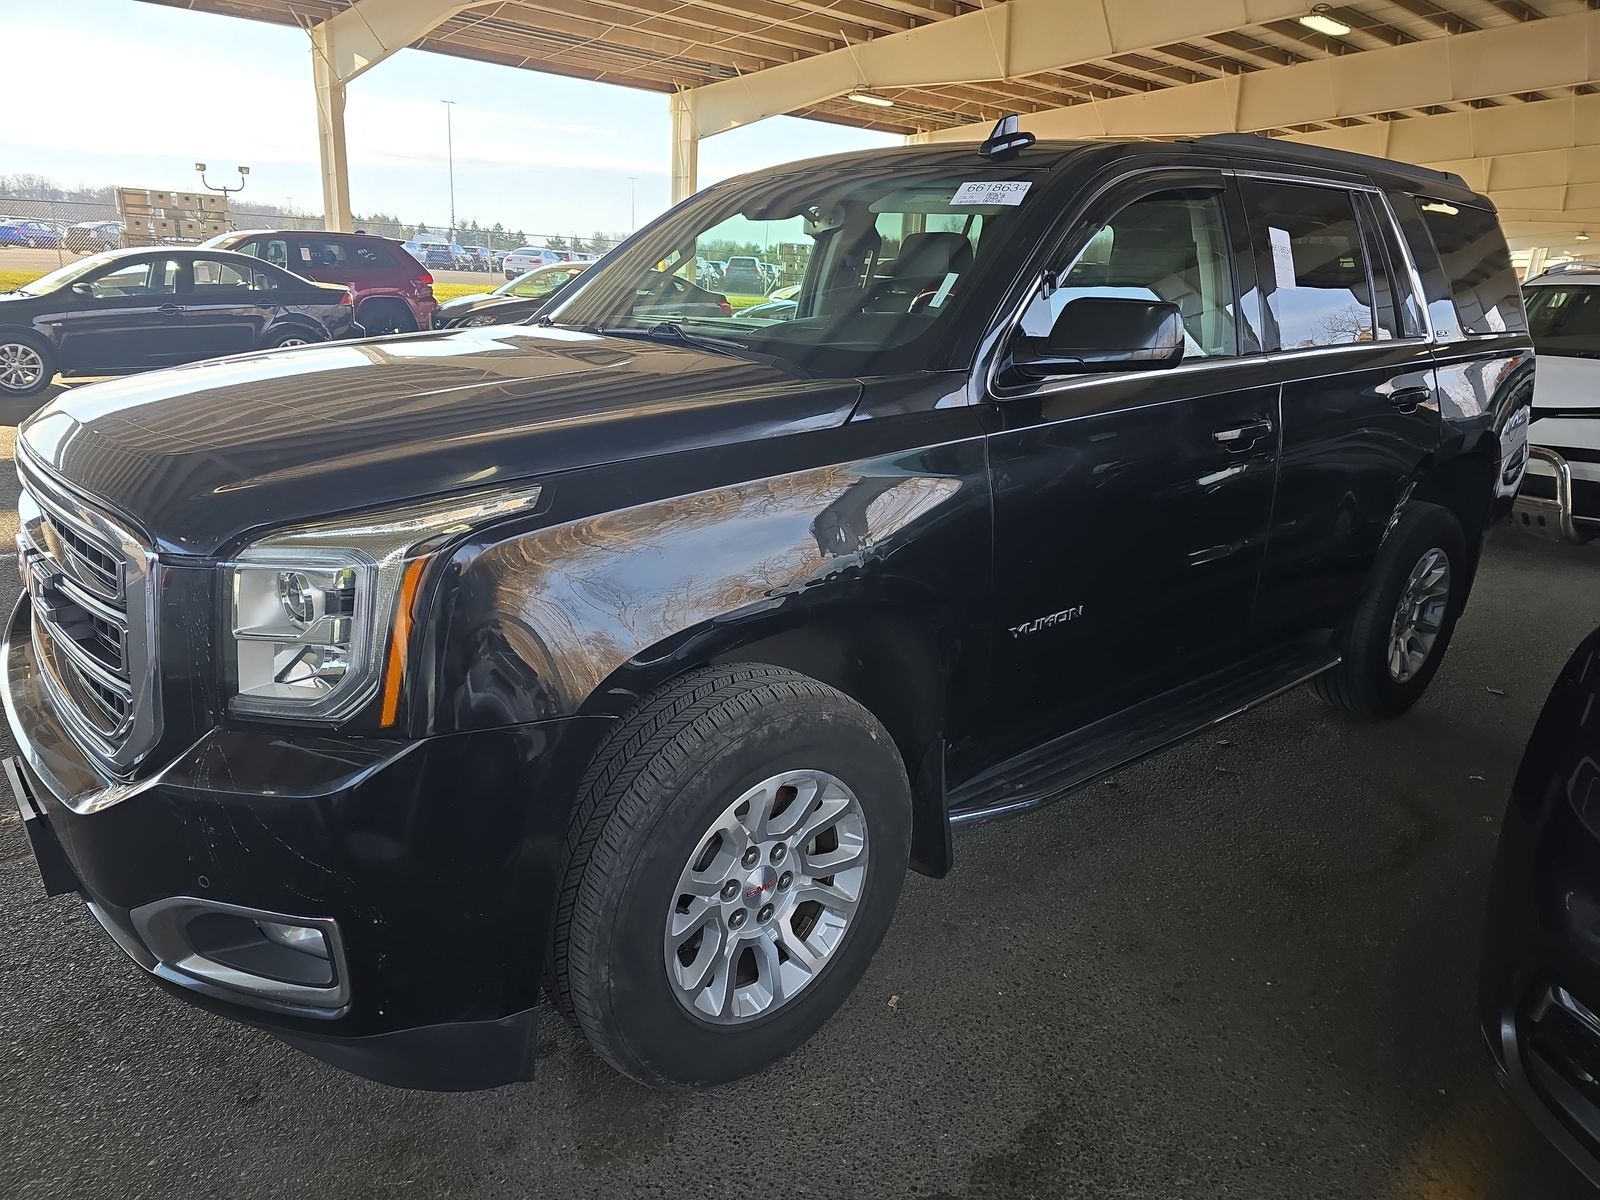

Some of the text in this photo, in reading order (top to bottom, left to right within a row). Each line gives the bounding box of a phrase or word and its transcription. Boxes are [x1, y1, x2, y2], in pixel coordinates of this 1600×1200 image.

[966, 183, 1028, 193] 6618634
[1008, 605, 1083, 639] YUKON
[746, 879, 774, 899] GMC
